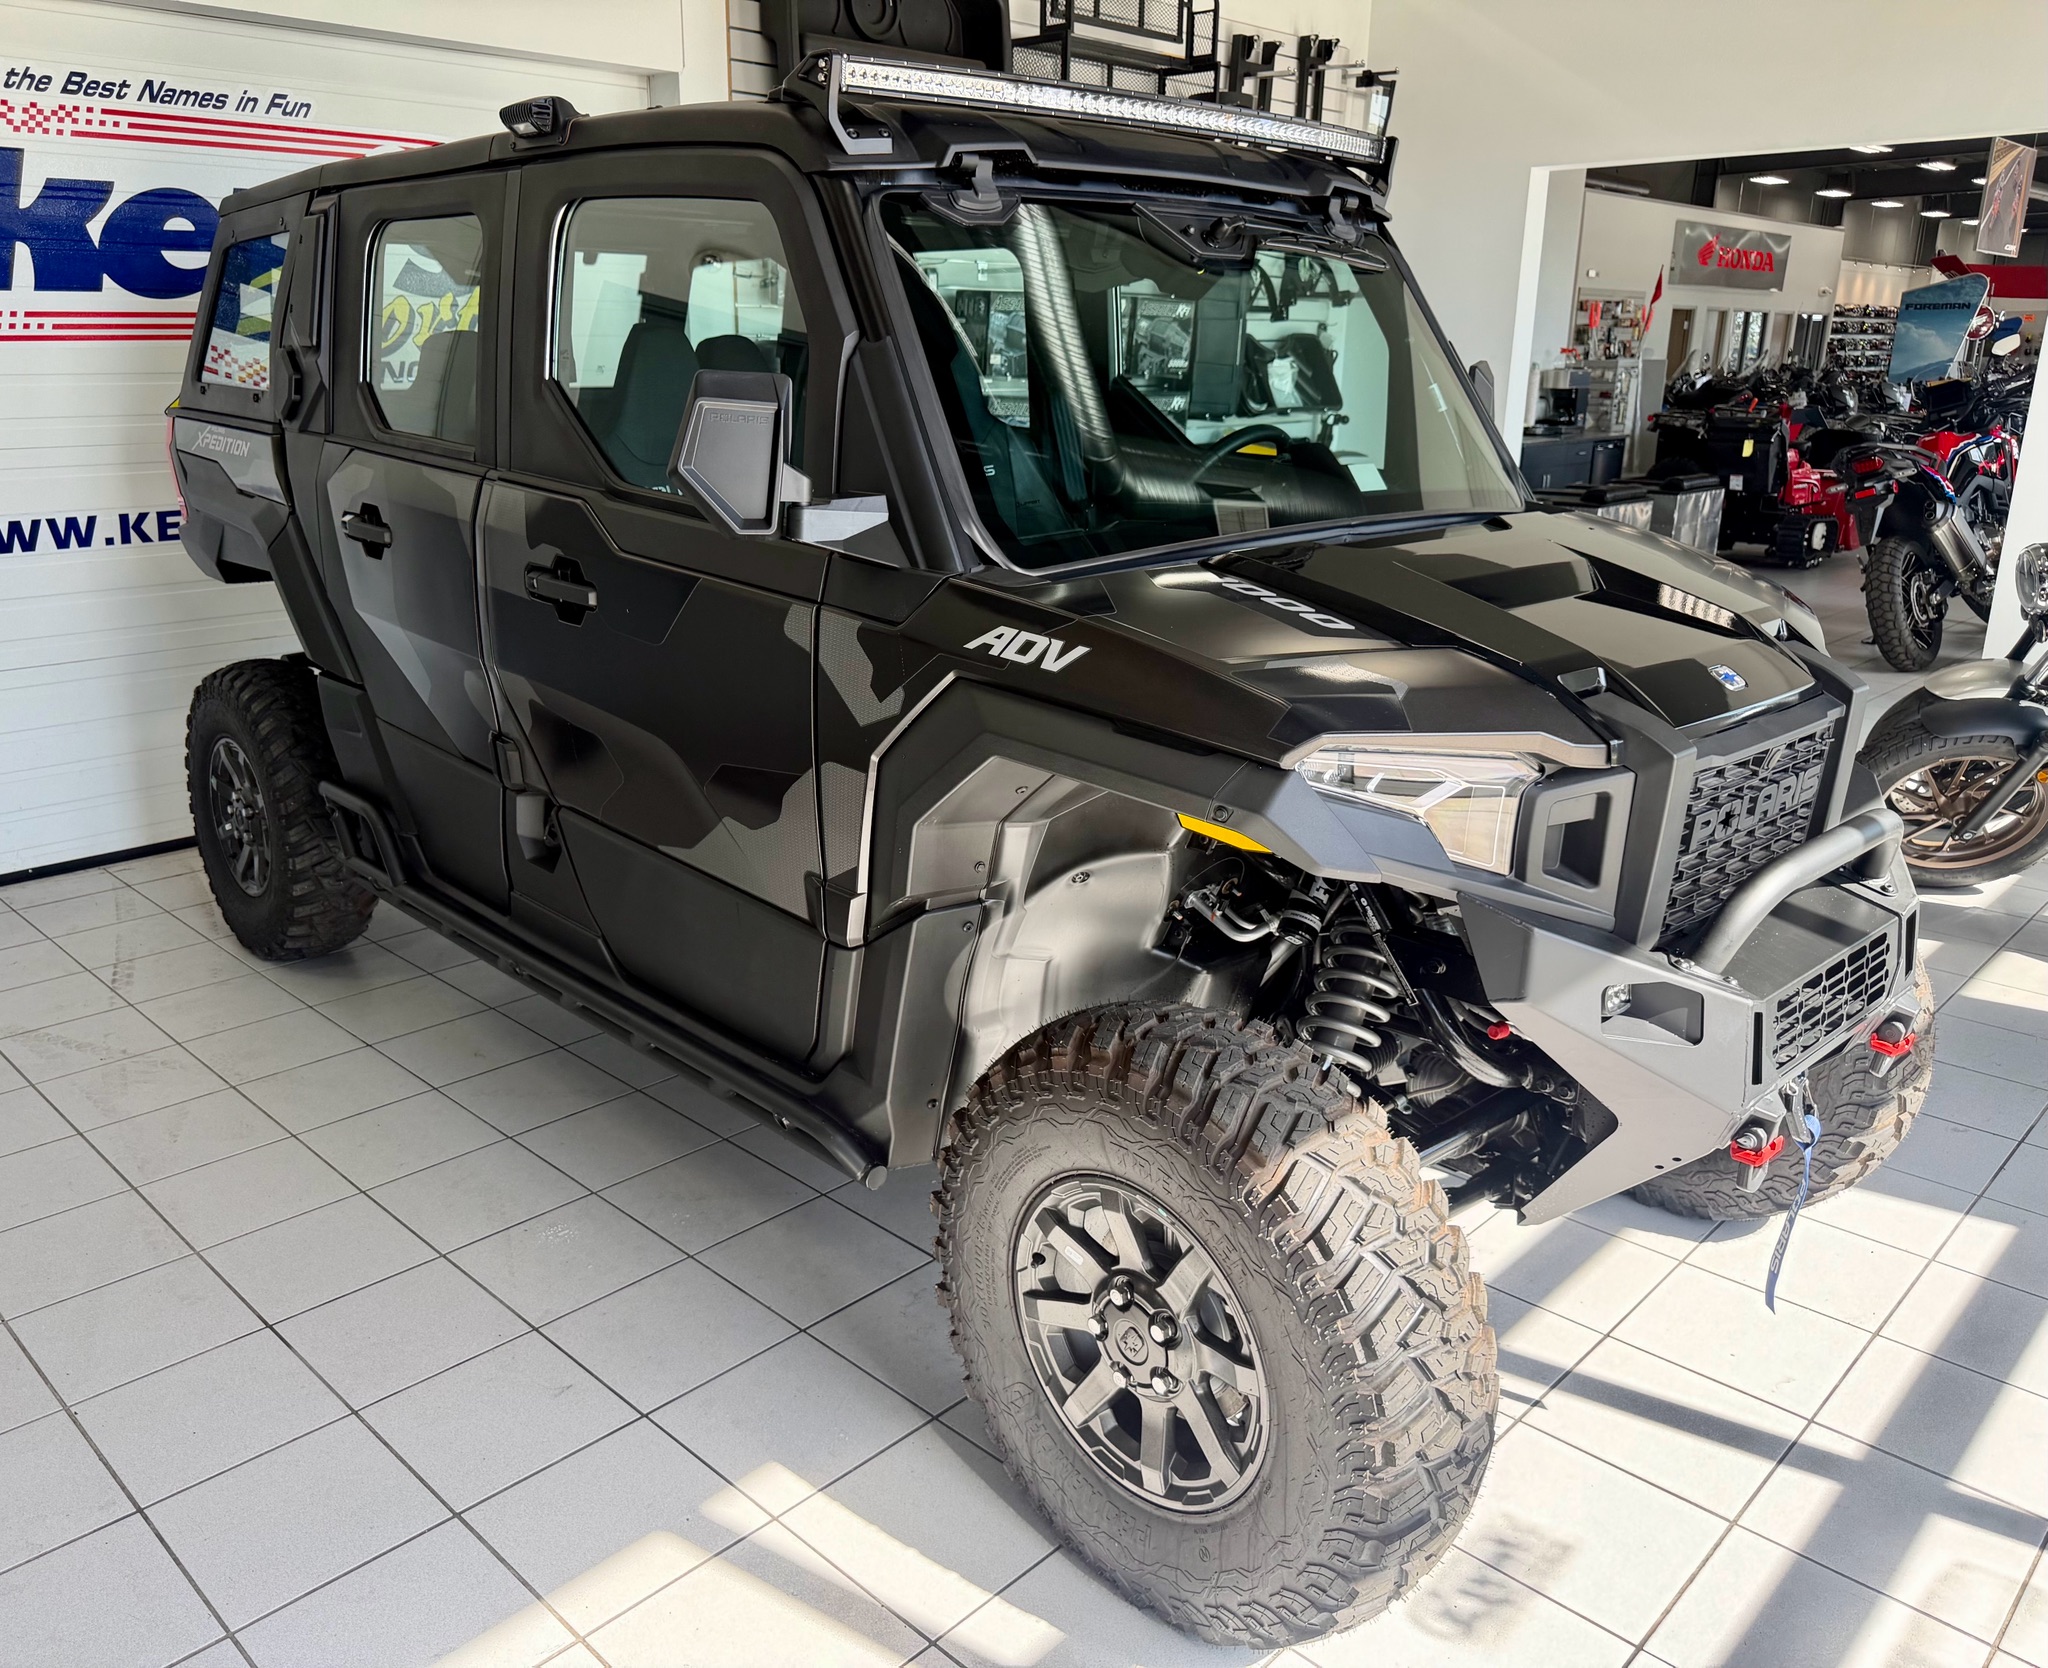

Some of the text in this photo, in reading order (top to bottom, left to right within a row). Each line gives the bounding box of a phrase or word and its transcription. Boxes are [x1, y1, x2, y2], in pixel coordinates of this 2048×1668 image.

[3, 66, 312, 118] the Best Names in Fun
[1716, 246, 1775, 273] HONDA
[1905, 302, 1971, 310] FOREMAN
[709, 412, 770, 425] POLARIS
[191, 425, 250, 457] XPEDITION
[963, 625, 1092, 673] ADV
[1689, 765, 1822, 853] POLARIS
[1770, 1178, 1806, 1274] POLARIS
